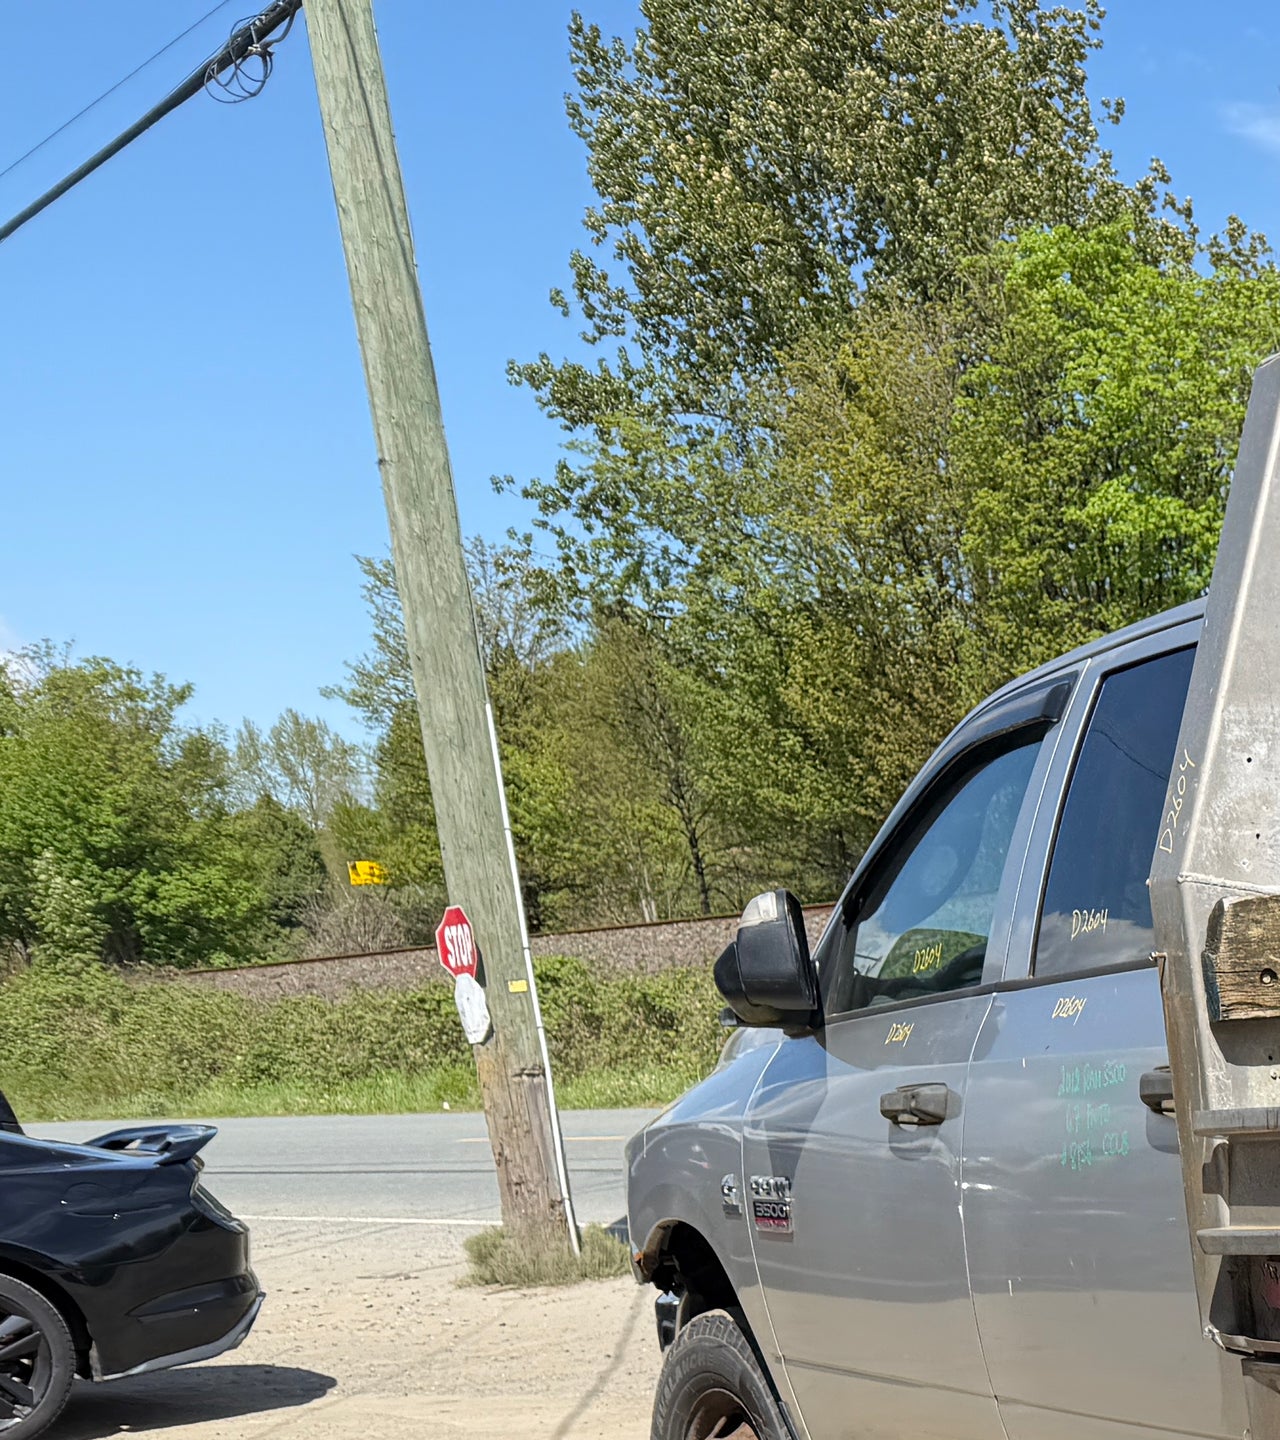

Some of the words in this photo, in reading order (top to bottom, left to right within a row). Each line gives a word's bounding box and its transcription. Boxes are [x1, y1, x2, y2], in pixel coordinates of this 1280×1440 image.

[1159, 748, 1196, 854] D2604
[1070, 908, 1109, 941] D2604
[444, 923, 473, 967] STOP
[913, 942, 943, 974] D2604
[1052, 996, 1087, 1026] D2604
[885, 1022, 914, 1047] D2604
[755, 1203, 786, 1217] 3500
